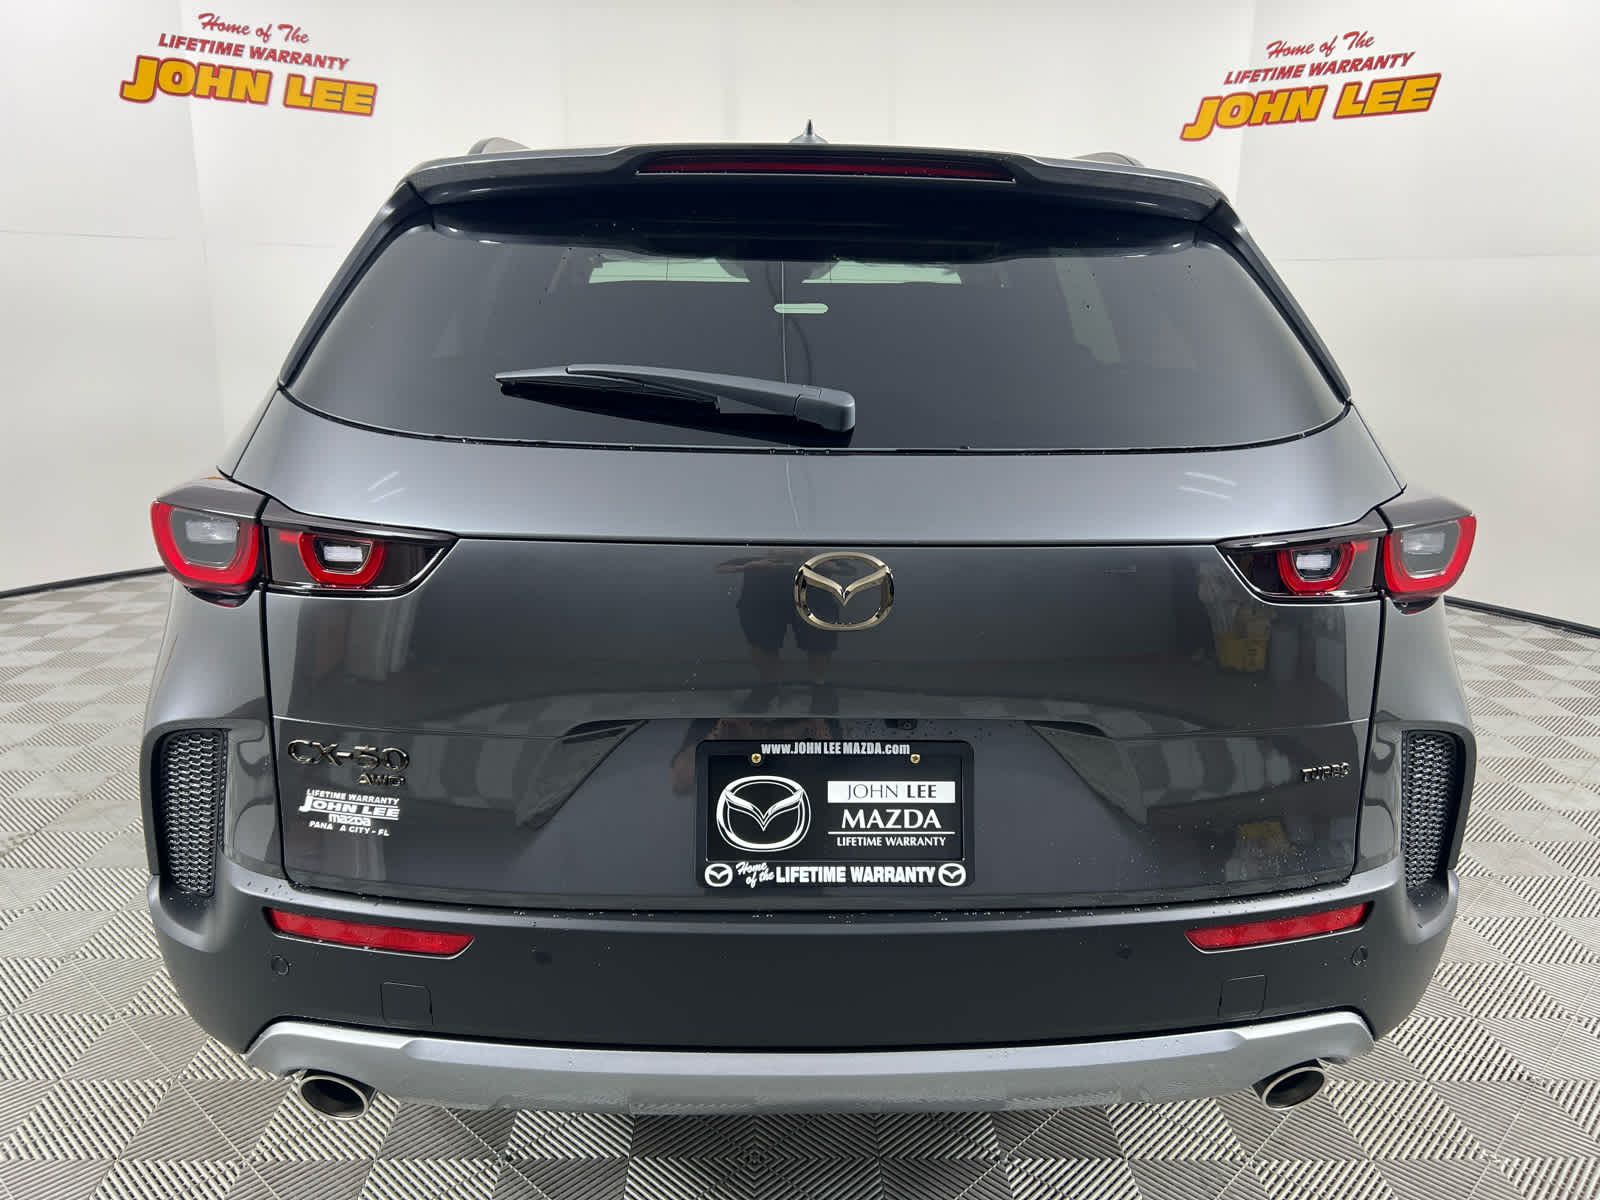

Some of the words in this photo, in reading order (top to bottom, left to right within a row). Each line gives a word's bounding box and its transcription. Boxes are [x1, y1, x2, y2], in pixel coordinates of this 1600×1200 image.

[198, 12, 250, 36] Home
[255, 23, 273, 44] of
[277, 24, 310, 44] The
[158, 32, 245, 58] LIFETIME
[249, 43, 350, 71] WARRANTY
[1266, 40, 1315, 59] Home
[1319, 35, 1339, 57] of
[1342, 30, 1376, 50] The
[1223, 63, 1306, 86] LIFETIME
[1308, 51, 1416, 78] WARRANTY
[119, 54, 274, 106] JOHN
[282, 73, 379, 118] LEE
[1179, 84, 1329, 142] JOHN
[1332, 72, 1442, 120] LEE
[287, 739, 410, 771] CX-50
[356, 771, 406, 787] AWD
[306, 788, 347, 801] LIFETIME
[348, 793, 400, 806] WARRANTY
[847, 783, 899, 801] JOHN
[906, 783, 937, 799] LEE
[298, 795, 358, 813] JOHN
[361, 804, 400, 818] LEE
[841, 808, 942, 829] MAZDA
[836, 836, 882, 847] LIFETIME
[884, 836, 946, 847] WARRANTY
[735, 861, 768, 875] Home
[745, 871, 758, 888] of
[758, 868, 775, 882] the
[776, 866, 846, 883] LIFETIME
[850, 866, 936, 884] WARRANTY
